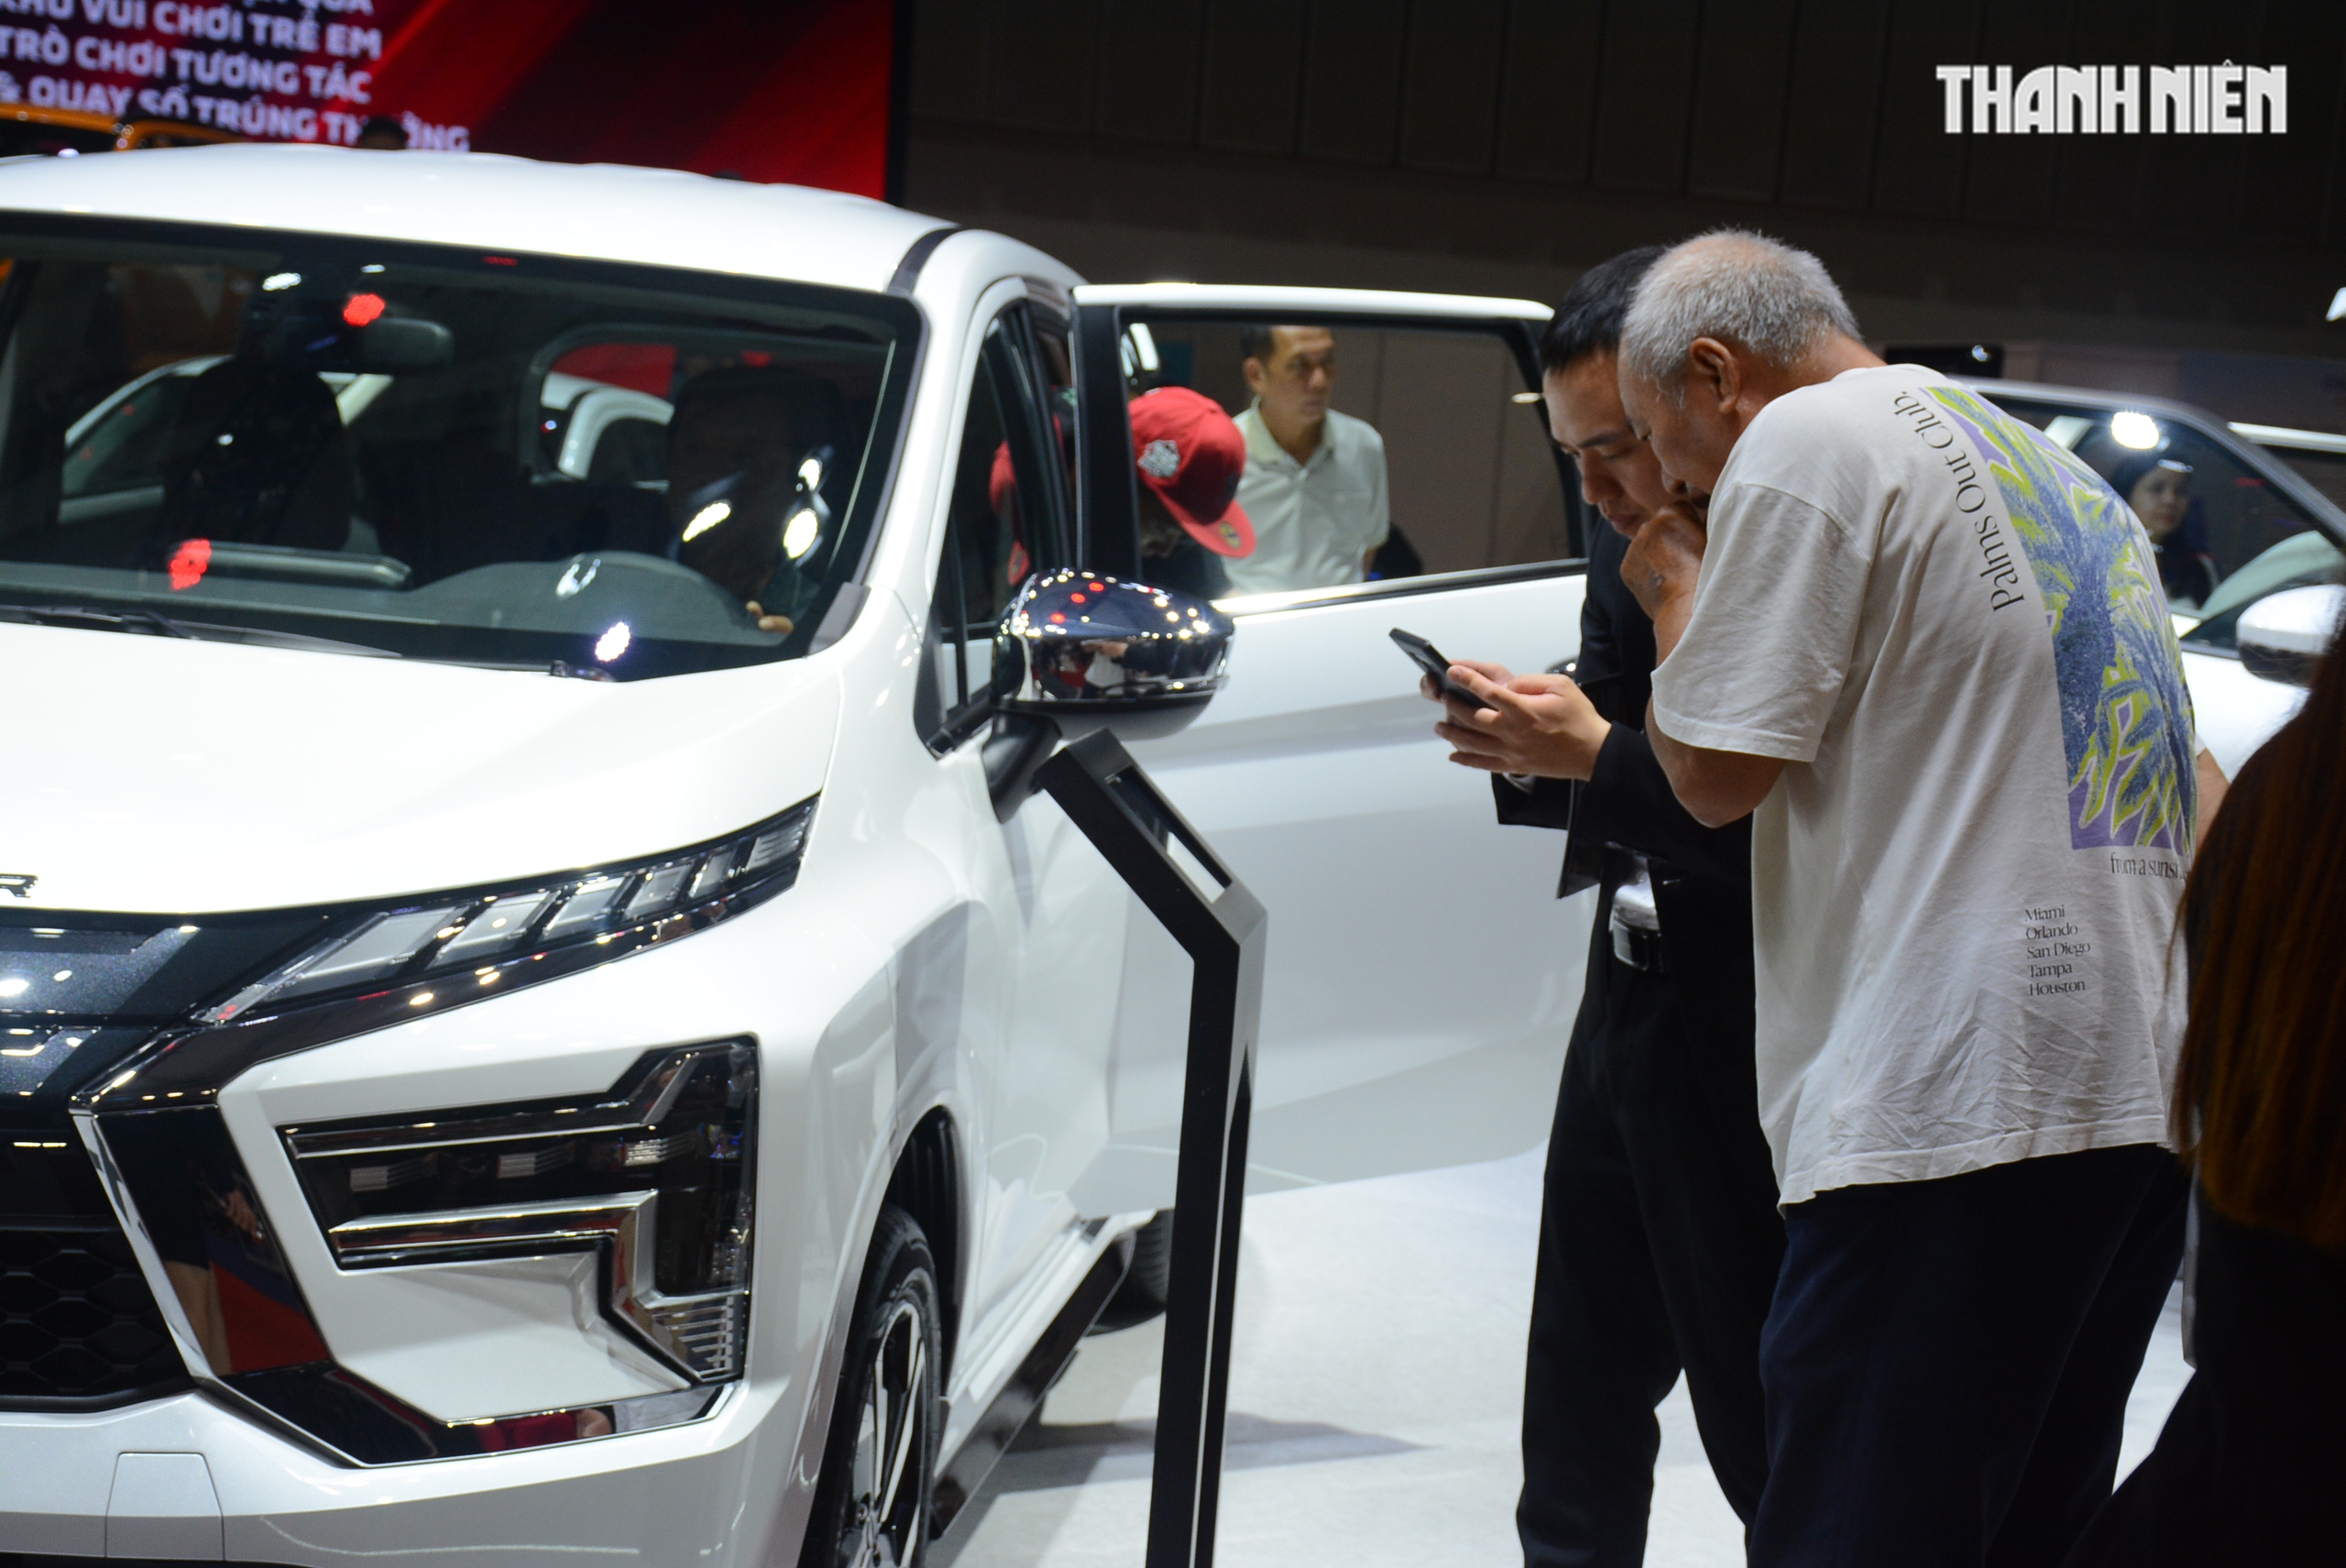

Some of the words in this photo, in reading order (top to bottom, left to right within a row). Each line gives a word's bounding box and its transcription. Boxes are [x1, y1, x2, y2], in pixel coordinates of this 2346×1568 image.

[82, 0, 147, 30] VUI
[152, 1, 244, 43] CHƠI
[324, 23, 382, 60] EM
[0, 24, 71, 67] TRÒ
[74, 35, 168, 79] CHƠI
[170, 48, 301, 95] TƯƠNG
[302, 60, 373, 105] TÁC
[28, 75, 134, 118] QUAY
[192, 94, 318, 142] TRÚNG
[1893, 390, 1954, 449] Club.
[1944, 449, 1986, 513] Out
[1974, 515, 2024, 611] Palms
[2110, 851, 2136, 875] from
[2139, 859, 2146, 875] a
[2024, 905, 2065, 921] Miami
[2025, 922, 2078, 940] Orlando
[2026, 946, 2051, 959] San
[2054, 942, 2091, 957] Diego
[2027, 963, 2073, 978] Tampa
[2029, 981, 2086, 996] Houston
